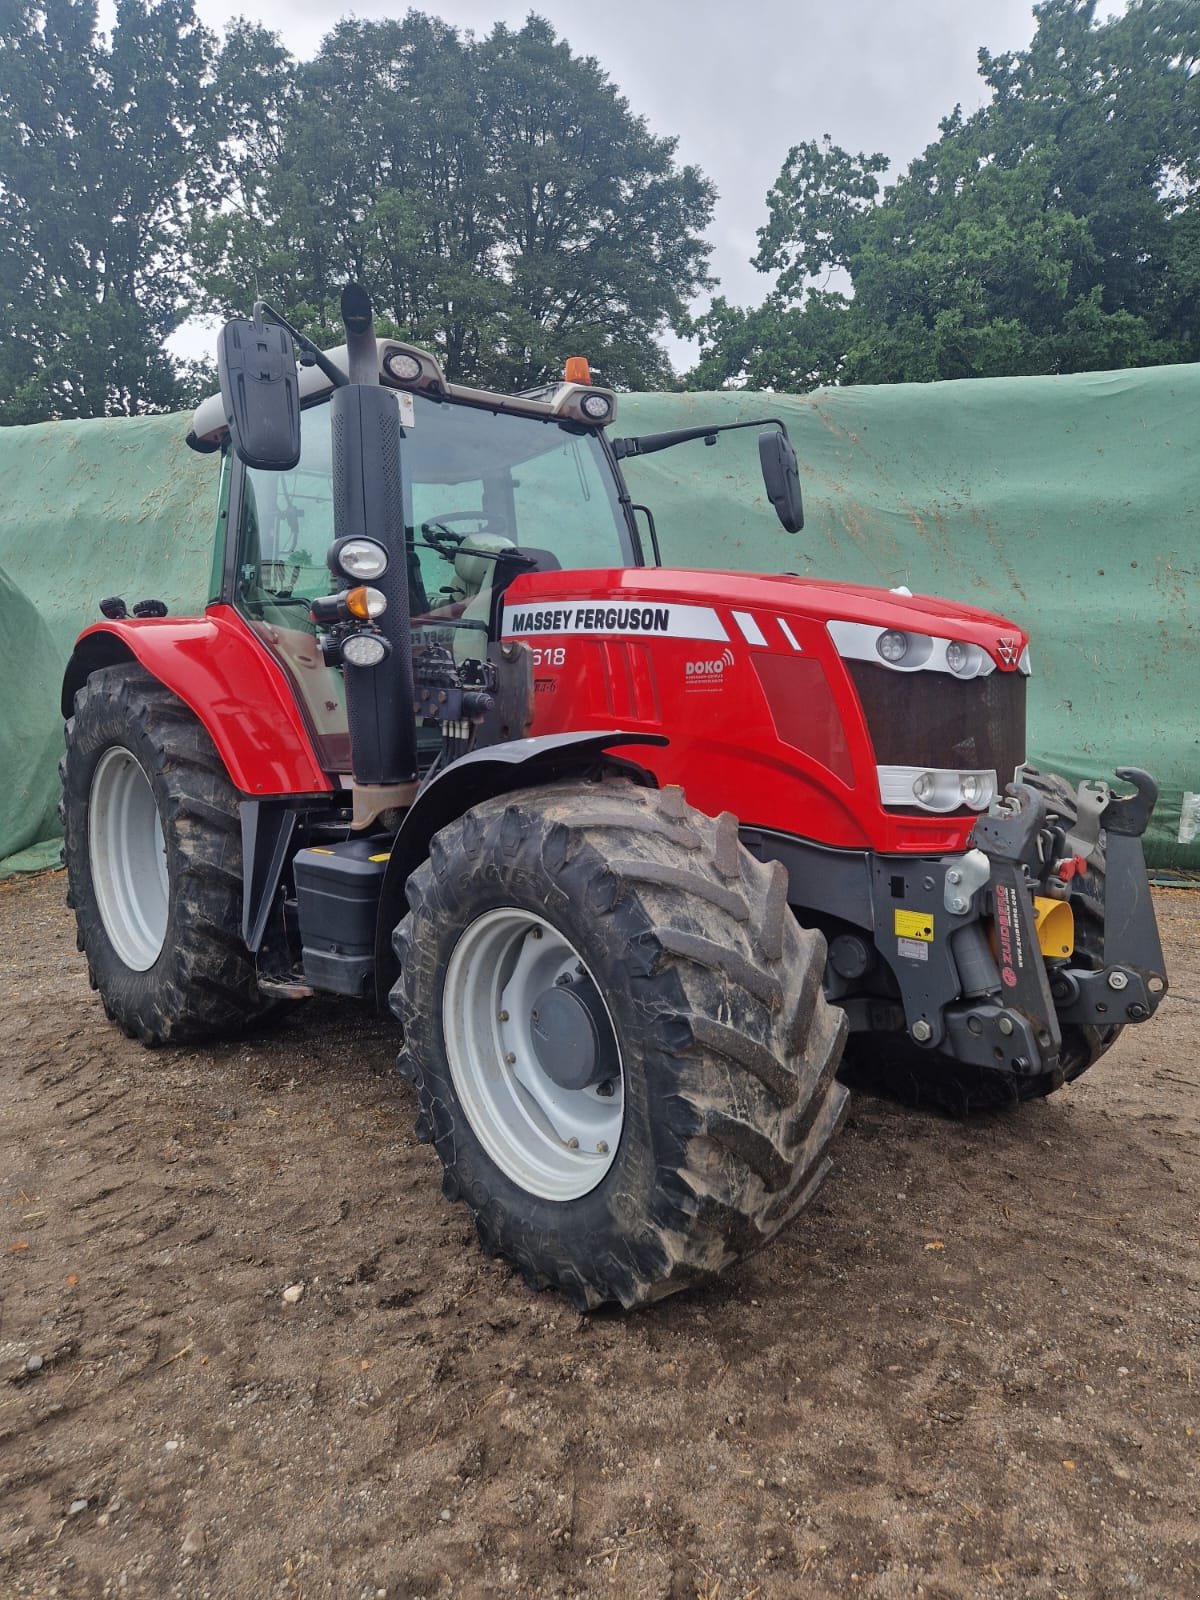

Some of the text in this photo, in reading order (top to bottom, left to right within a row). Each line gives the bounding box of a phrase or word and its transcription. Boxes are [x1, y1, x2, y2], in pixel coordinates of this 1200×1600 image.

[512, 608, 669, 632] MASSEY FERGUSON
[685, 660, 724, 675] DOKO
[996, 884, 1013, 966] ZUIDBERG
